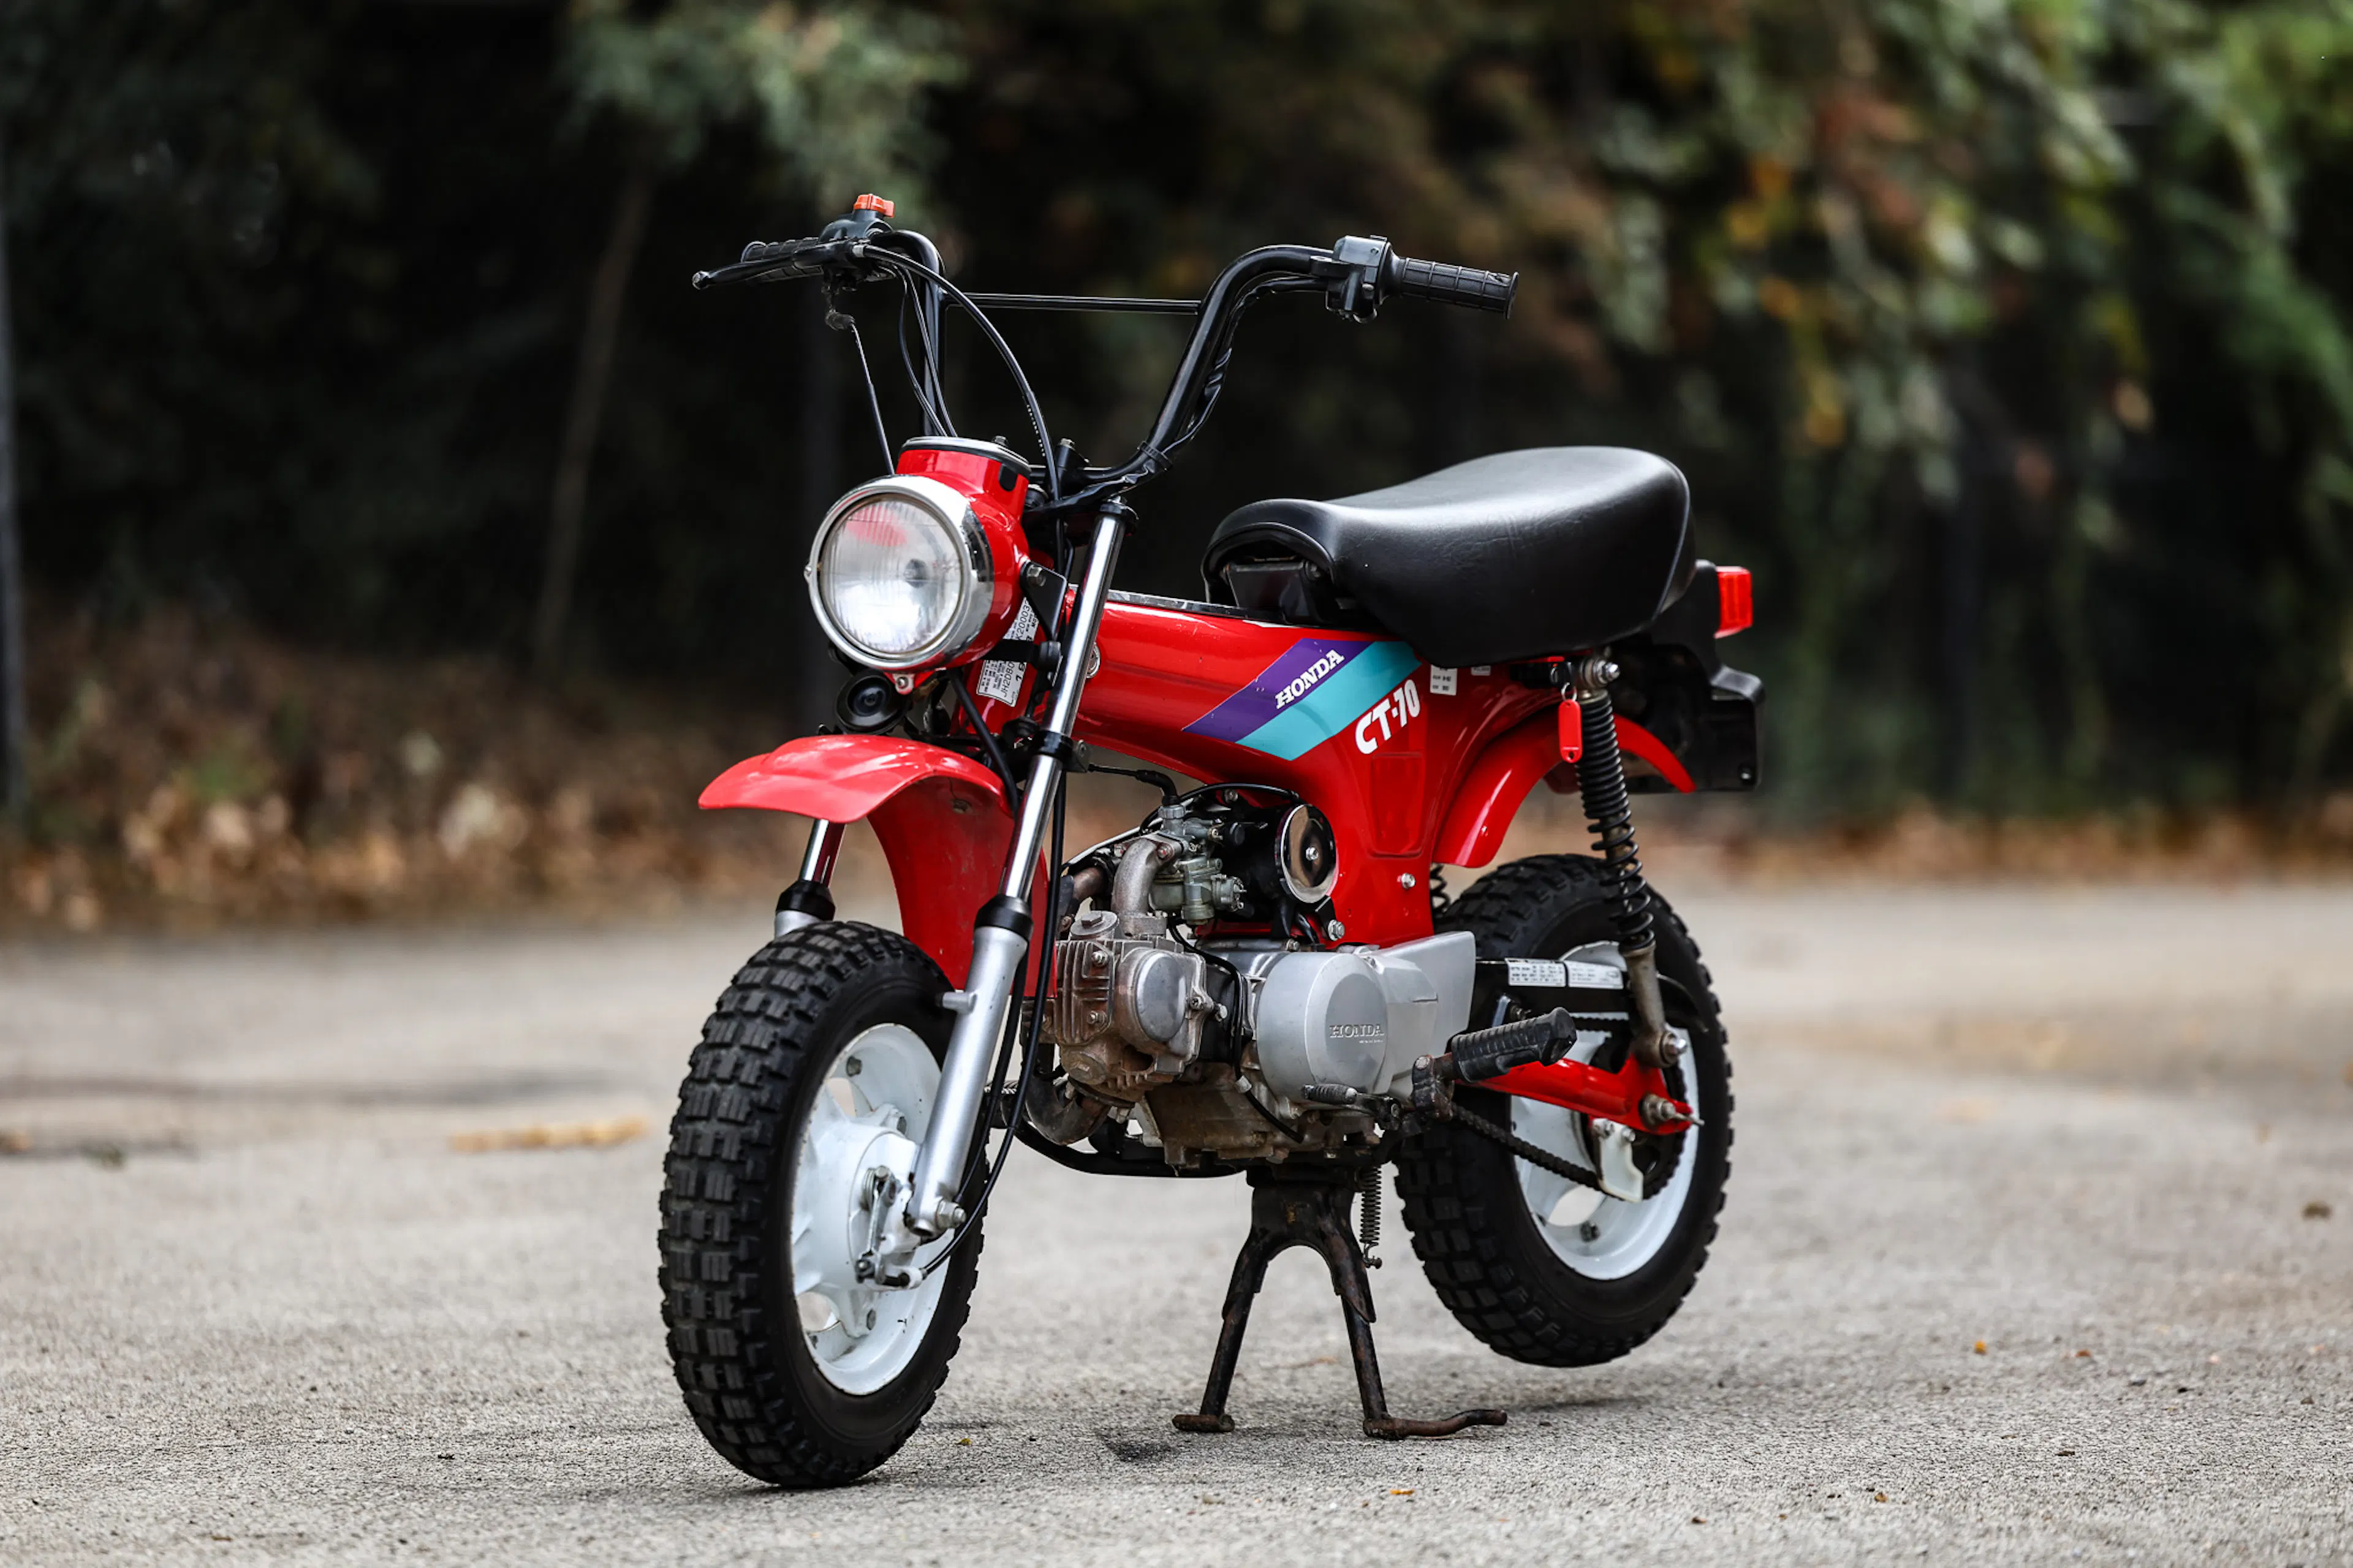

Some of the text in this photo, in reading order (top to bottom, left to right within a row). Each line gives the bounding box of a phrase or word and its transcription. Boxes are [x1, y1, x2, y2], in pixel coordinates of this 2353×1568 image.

[1275, 650, 1344, 709] HONDA
[1355, 679, 1420, 754] CT-70
[1330, 1024, 1385, 1038] HONDA
